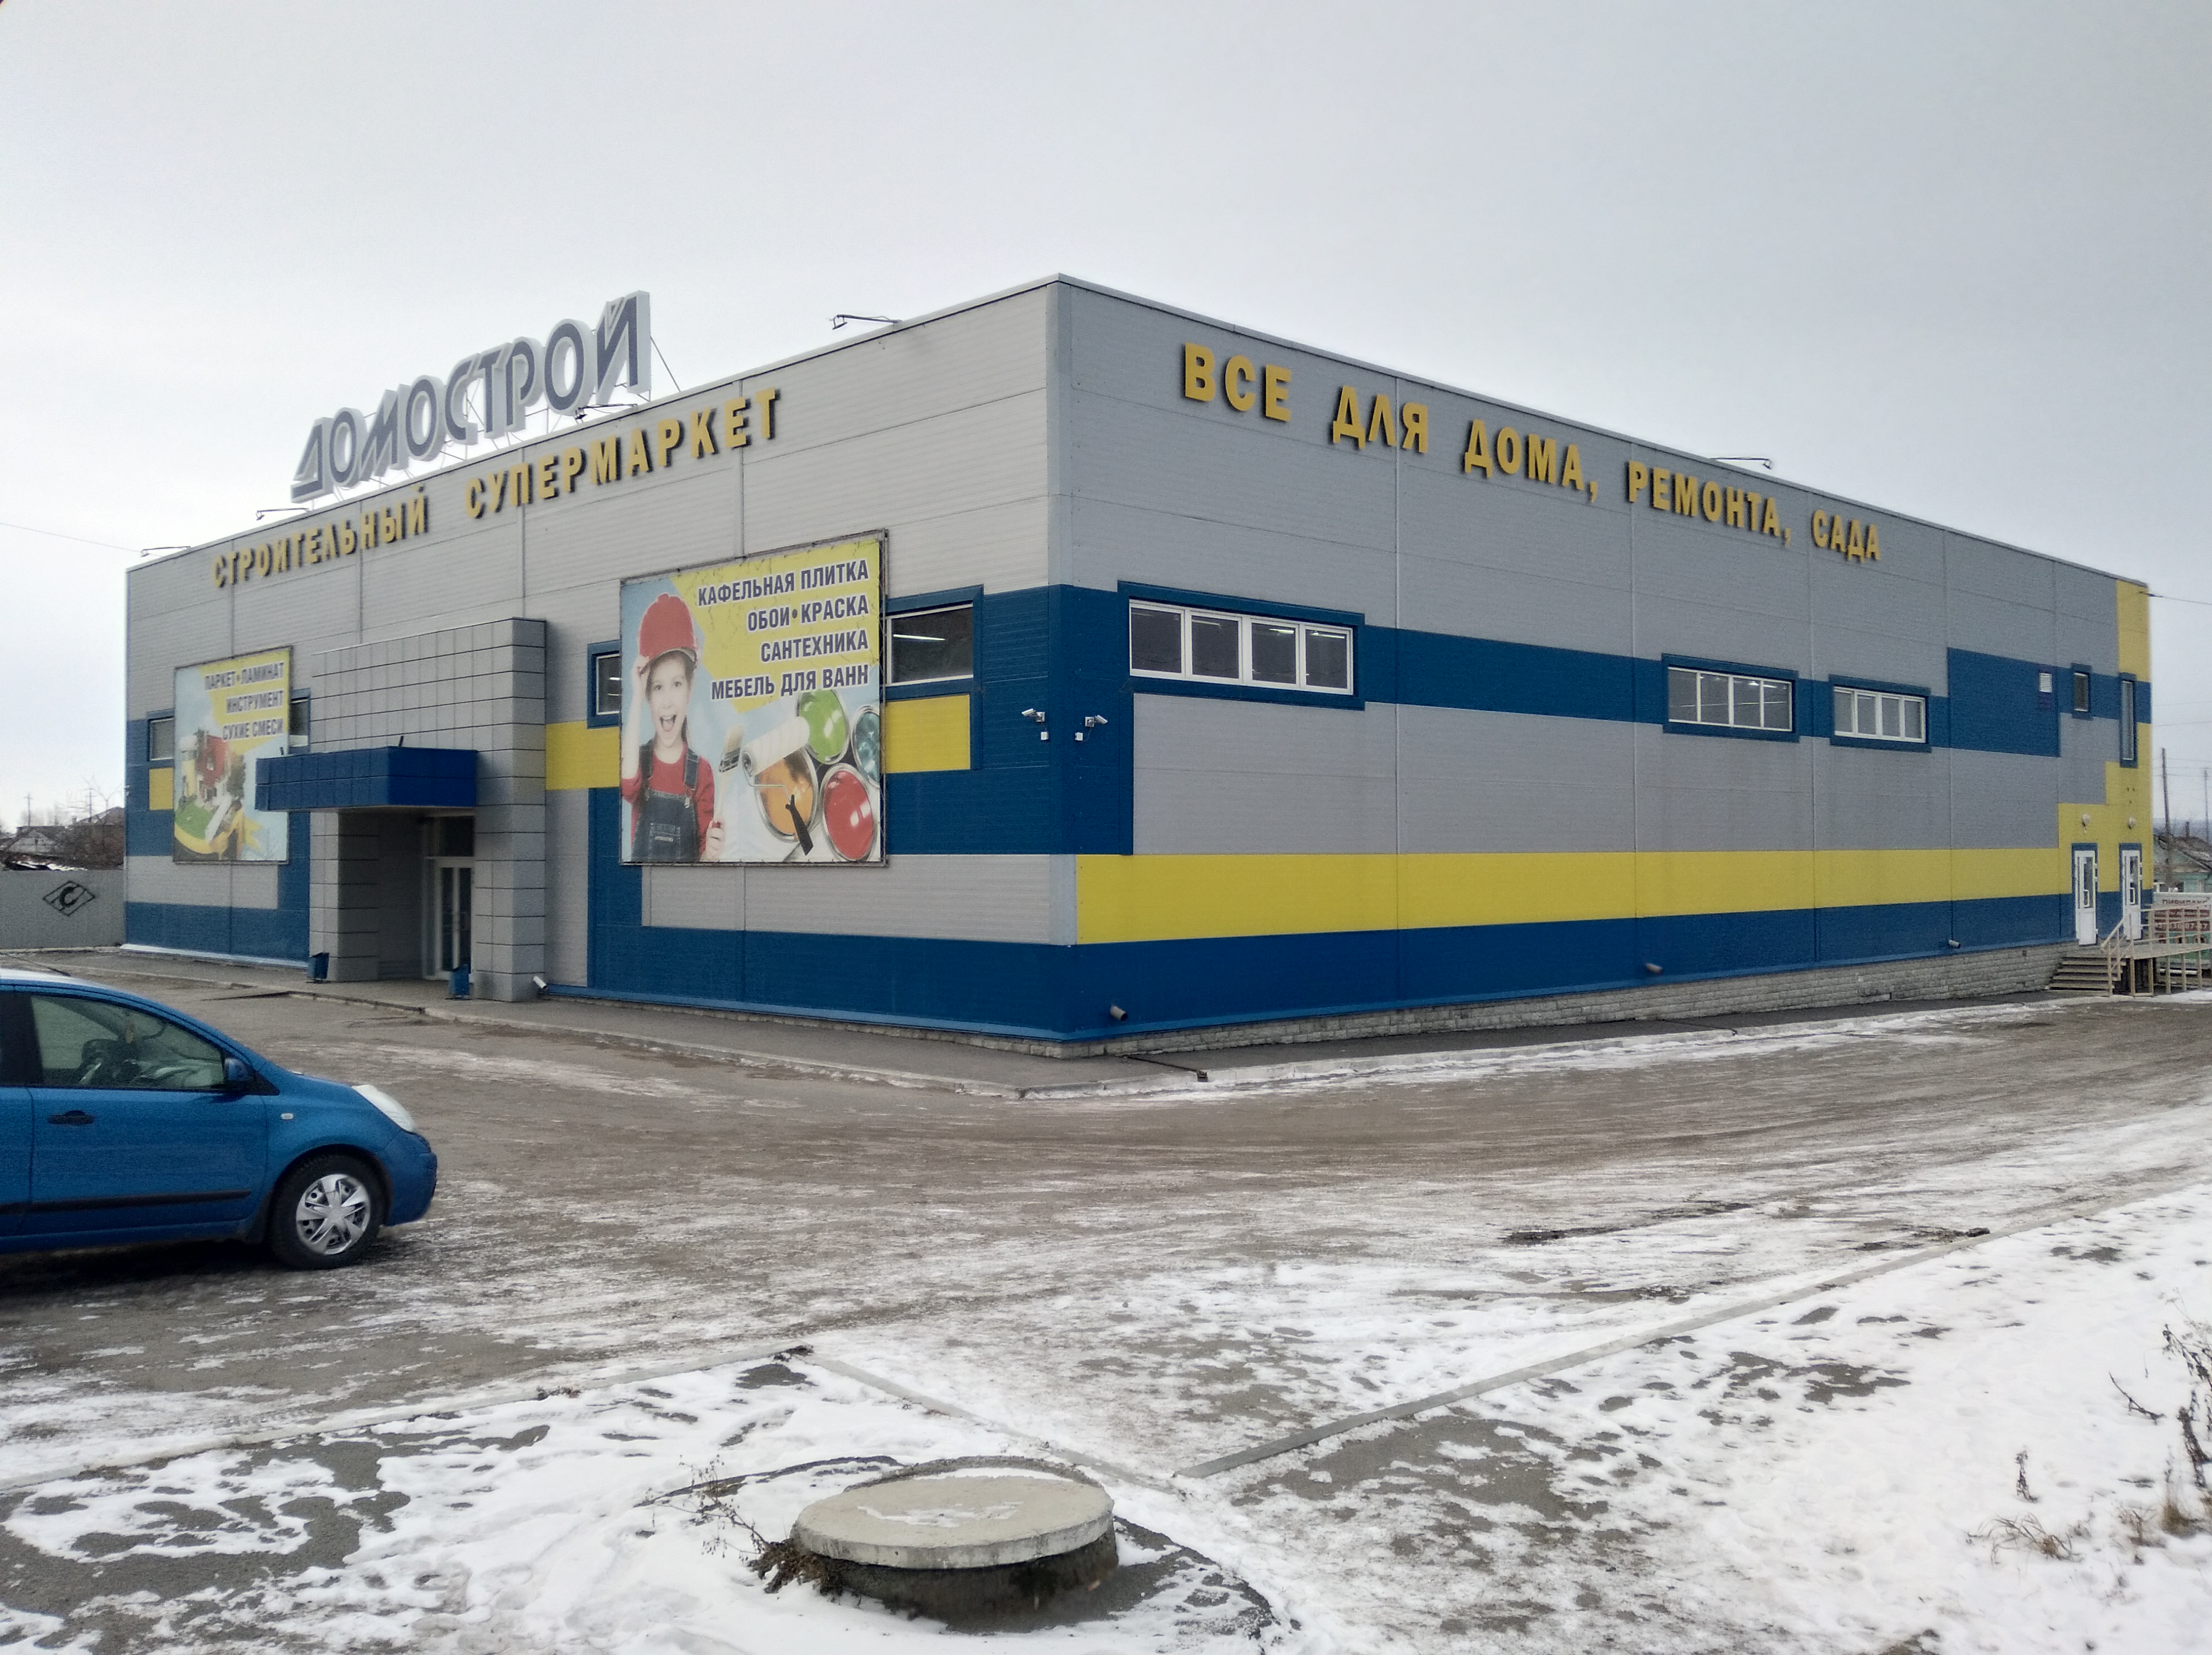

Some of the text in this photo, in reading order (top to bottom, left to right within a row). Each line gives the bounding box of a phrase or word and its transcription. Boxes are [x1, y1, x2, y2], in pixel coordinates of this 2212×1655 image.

[290, 290, 651, 504] ДОМОСТРОЙ
[1183, 341, 1881, 564] ВСЕ ДЛЯ ДОМА, РЕМОНТА, САДА
[212, 387, 781, 588] СТРОИТЕЛЬНЫЙ СУПЕРМАРКЕТ
[697, 559, 869, 606] КАФЕЛЬНАЯ ПЛИТКА
[747, 594, 870, 632] ОБОИ КРАСКА
[760, 629, 868, 662] САНТЕХНИКА
[711, 664, 869, 701] МЕБЕЛЬ ДЛЯ ВАНН
